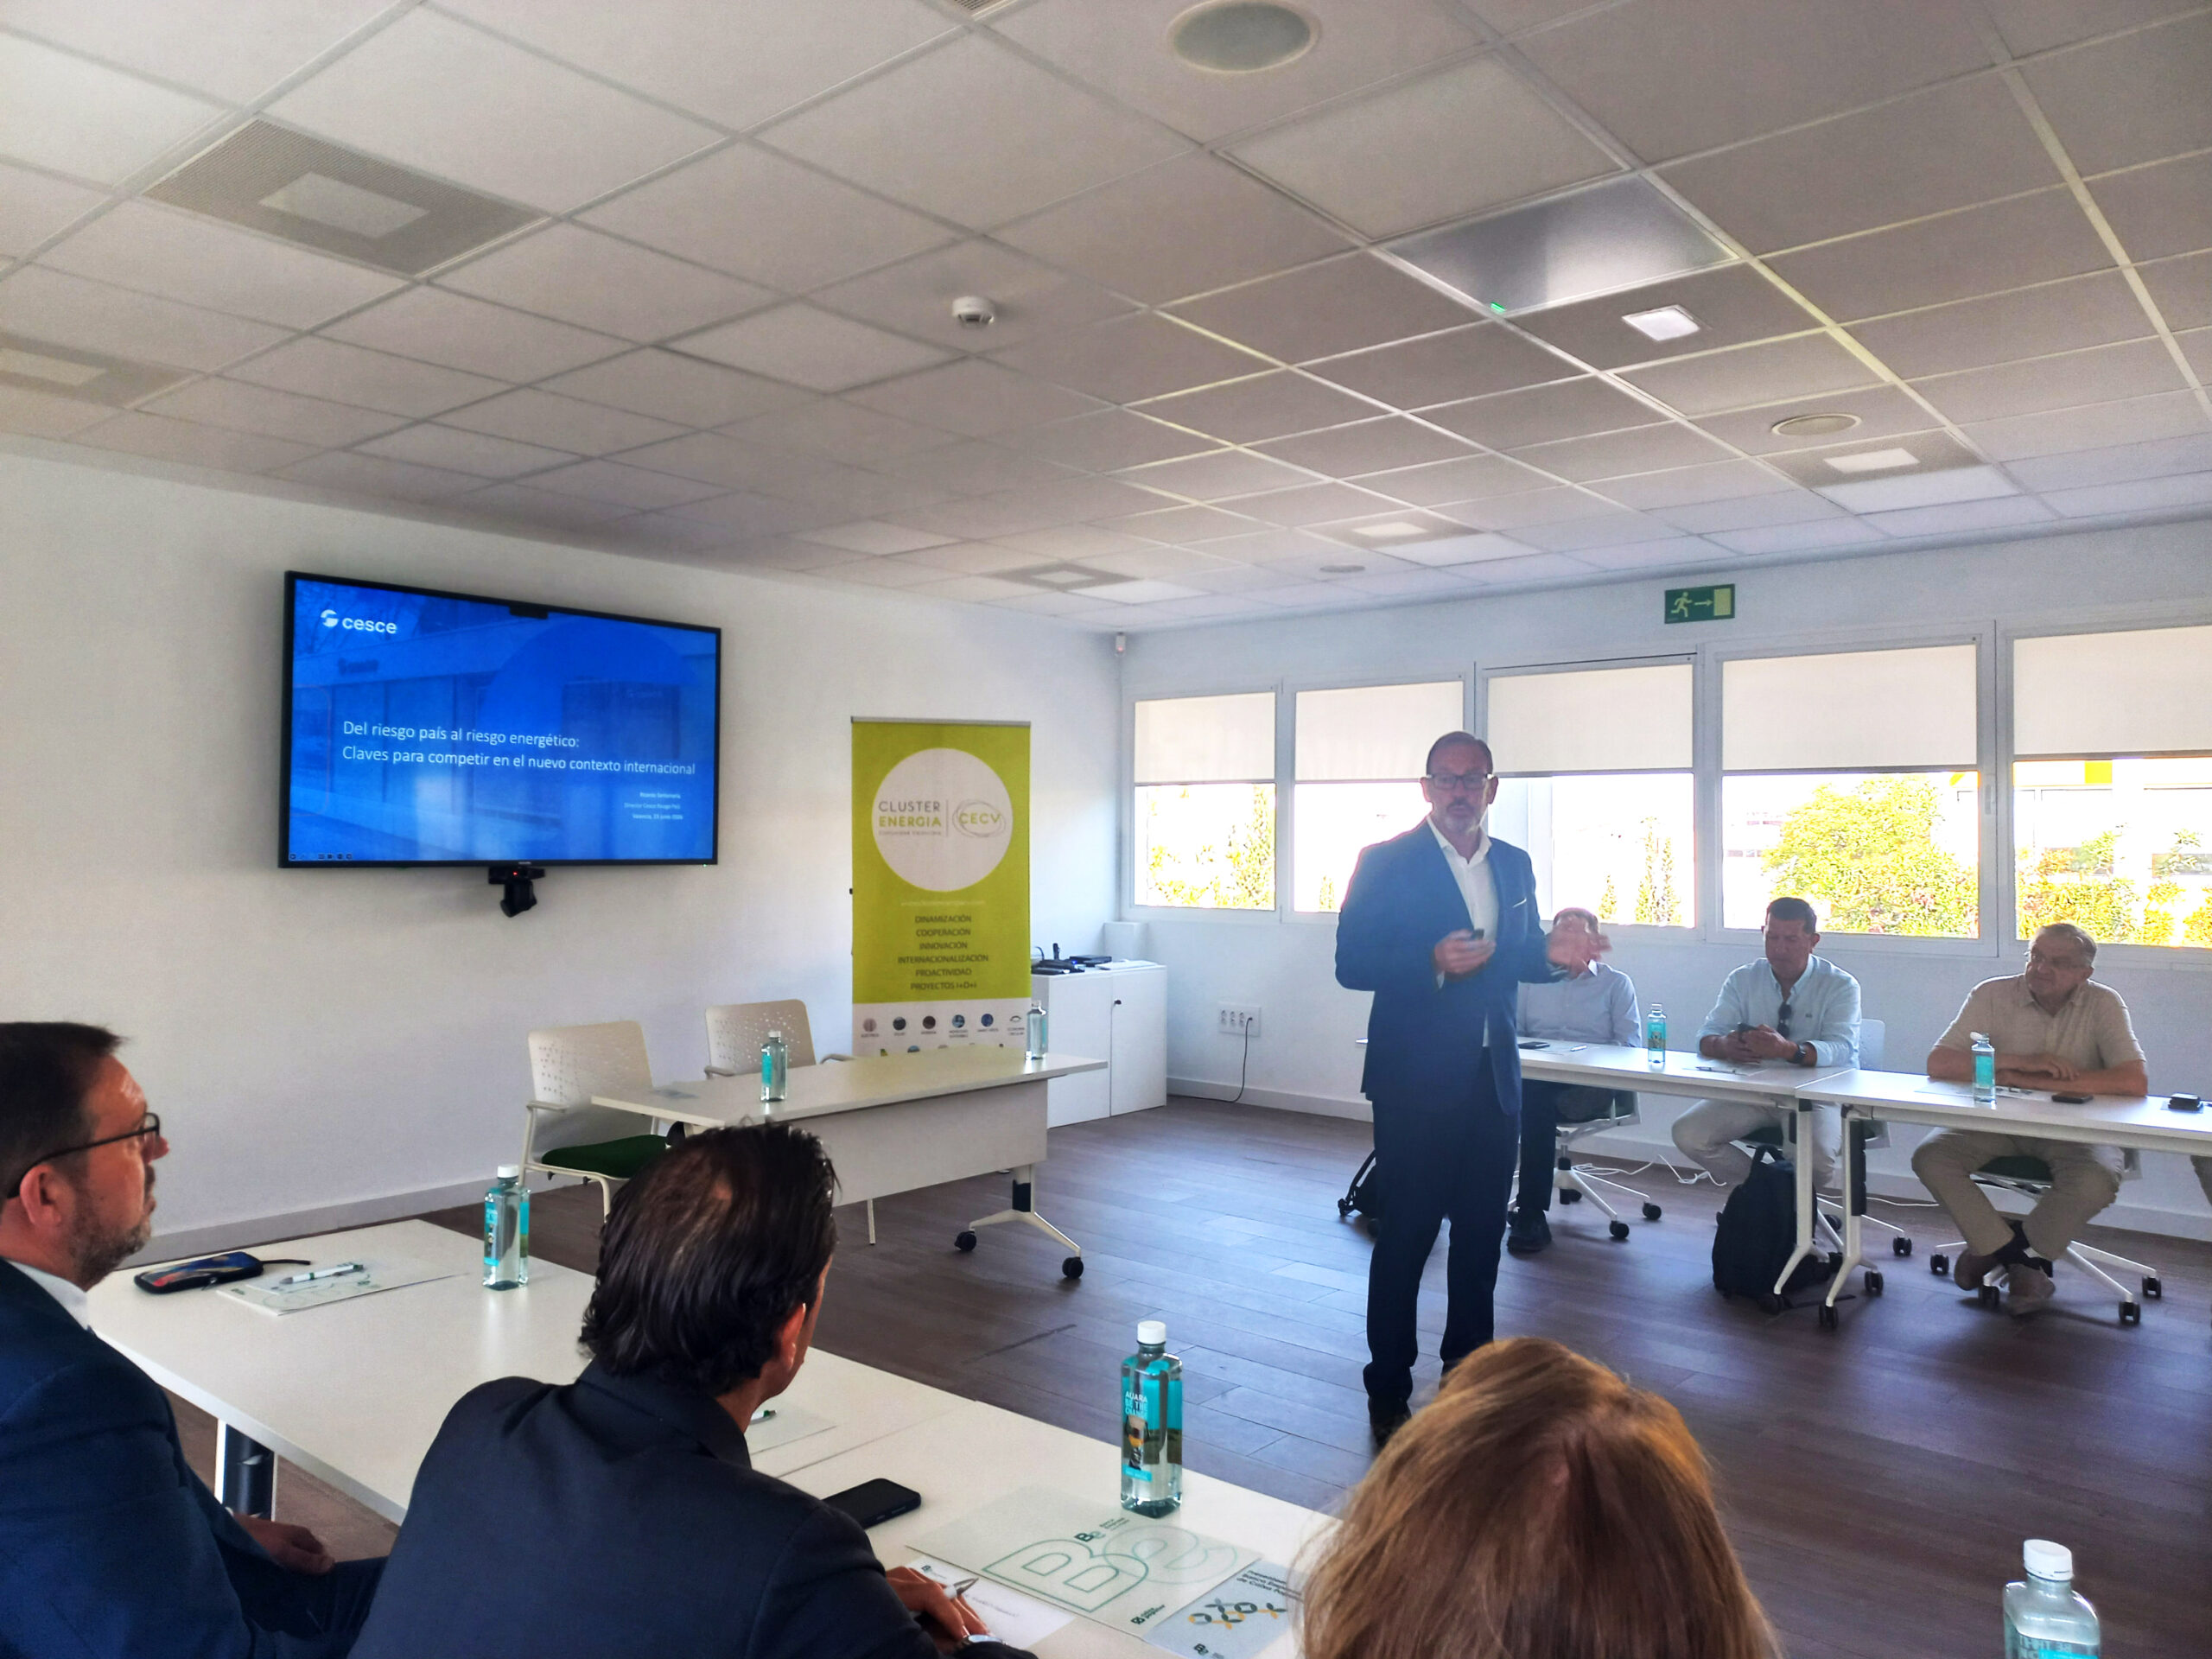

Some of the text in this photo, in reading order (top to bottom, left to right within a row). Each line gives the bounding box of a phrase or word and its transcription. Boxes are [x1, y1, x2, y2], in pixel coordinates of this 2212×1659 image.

[342, 617, 397, 634] cesce
[343, 721, 580, 748] Del riesgo país al riesgo energético:
[342, 746, 696, 775] Claves para competir en el nuevo contexto internacional
[878, 801, 940, 813] CLUSTER
[959, 812, 1001, 824] CECV
[915, 968, 972, 976] PROACTIVIDAD
[1125, 1390, 1148, 1403] AUARA
